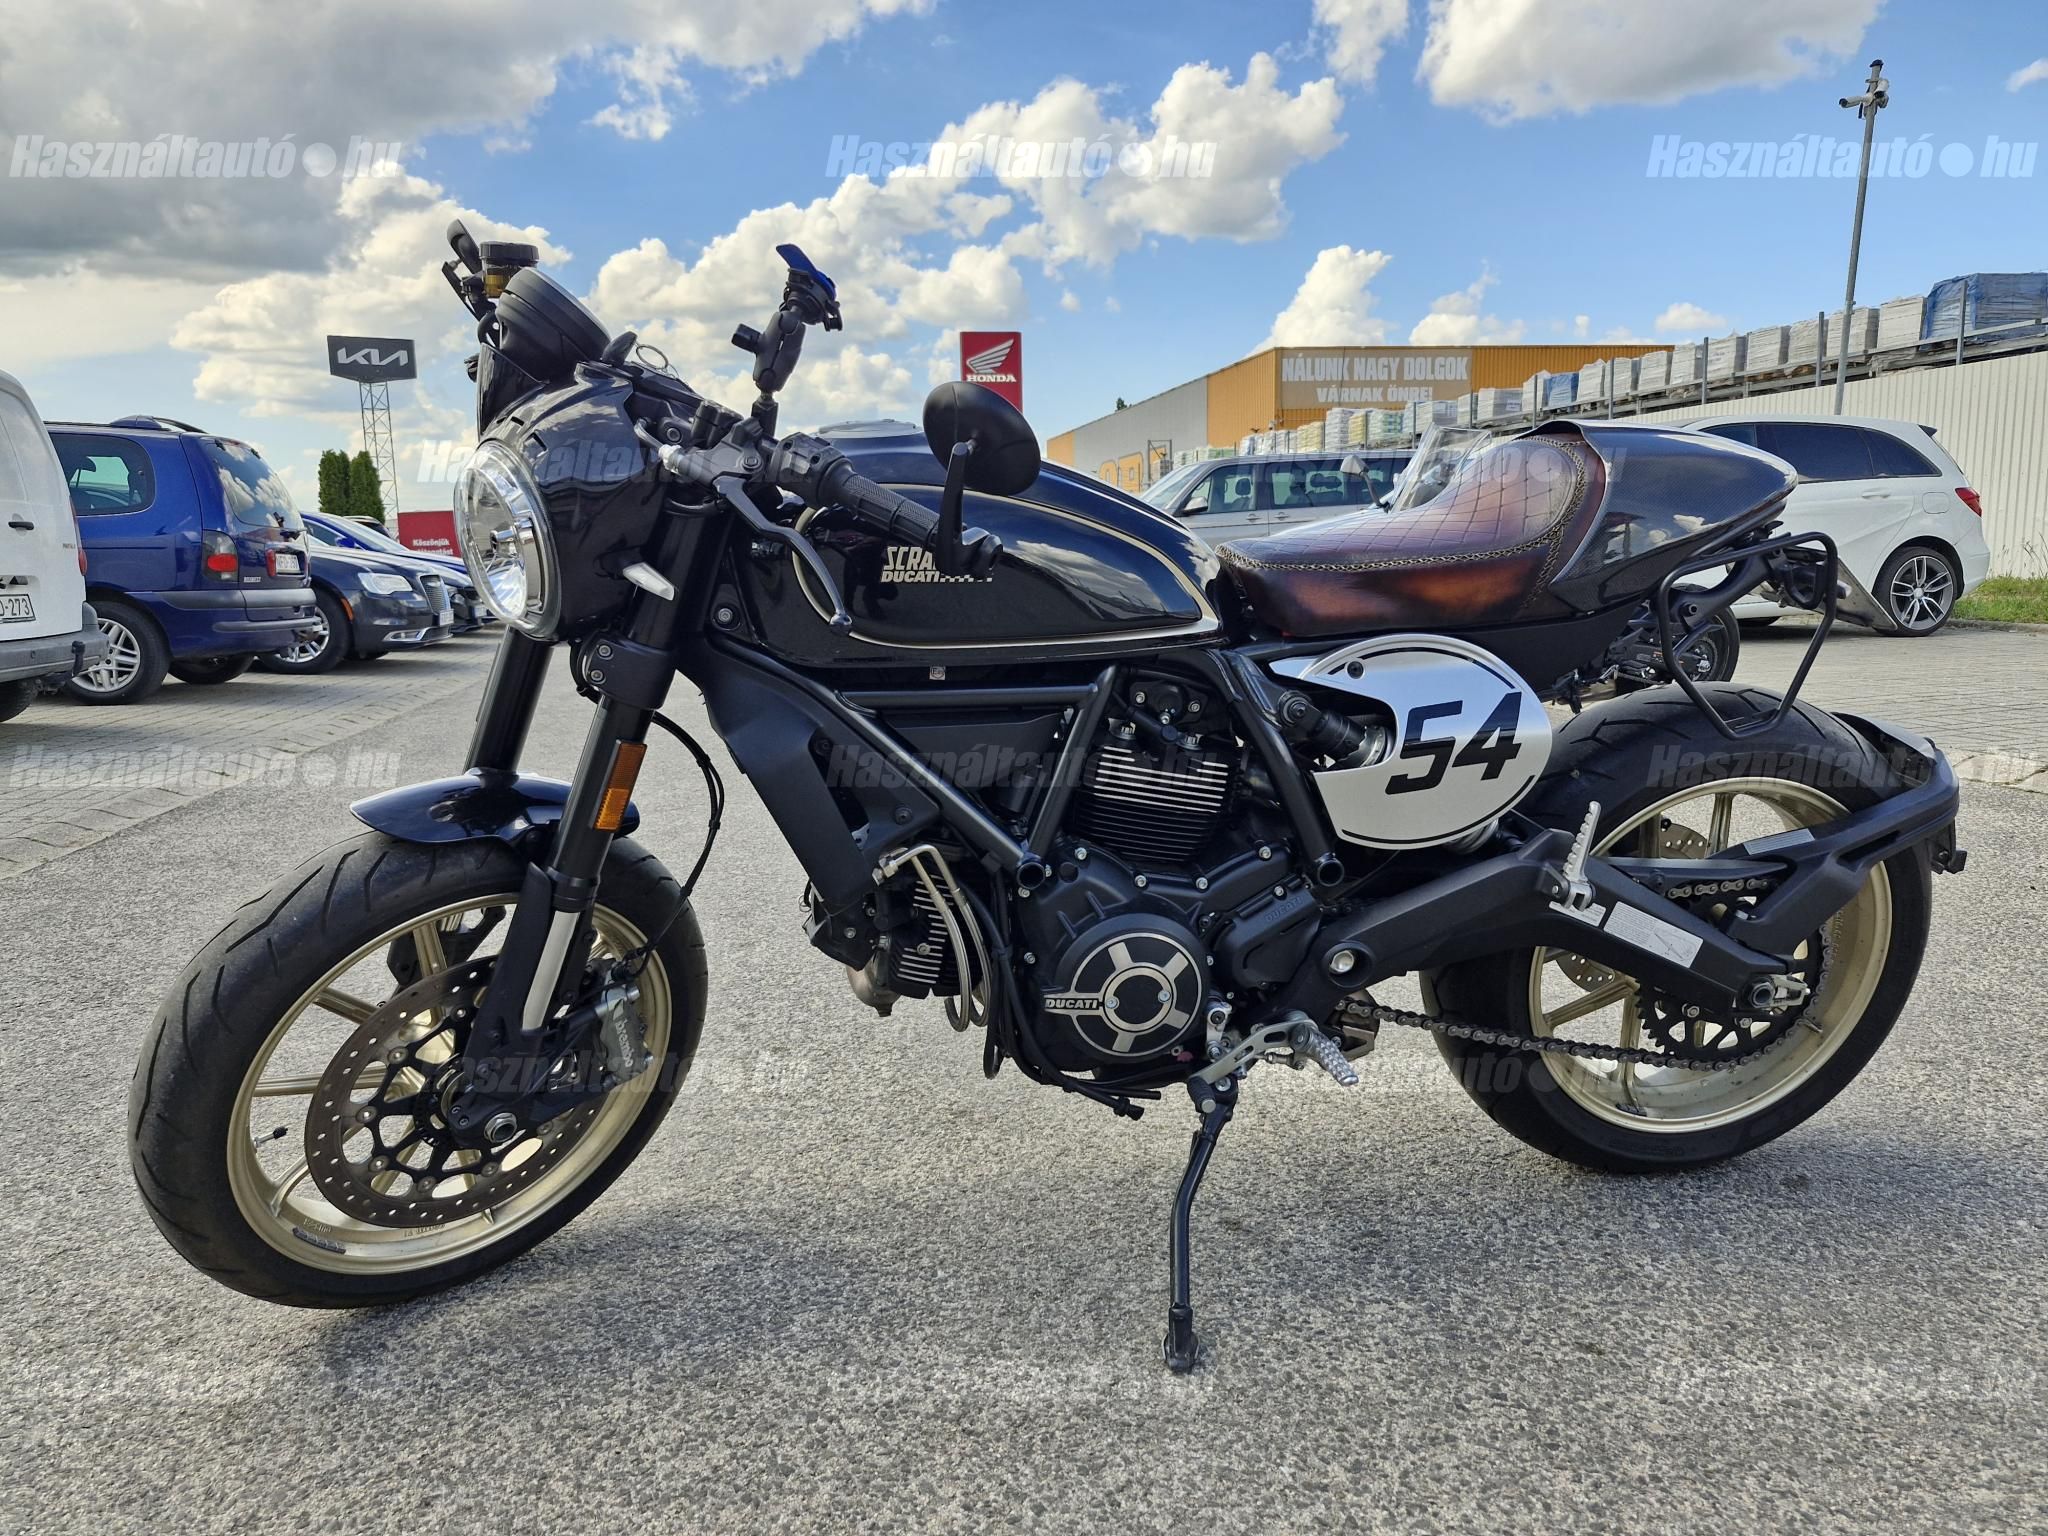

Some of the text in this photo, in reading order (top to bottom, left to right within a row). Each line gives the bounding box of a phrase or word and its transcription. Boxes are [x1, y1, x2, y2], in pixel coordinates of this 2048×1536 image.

[337, 347, 409, 367] KIA
[1282, 353, 1468, 382] NÁLUNK NAGY DOLGOK
[966, 374, 1017, 383] HONDA
[1316, 384, 1384, 403] VÁRNAK
[413, 539, 450, 547] Köszönjük
[881, 571, 940, 583] DUCATI
[1385, 691, 1522, 795] 54
[1045, 999, 1098, 1009] DUCATI
[615, 1019, 634, 1068] brembo
